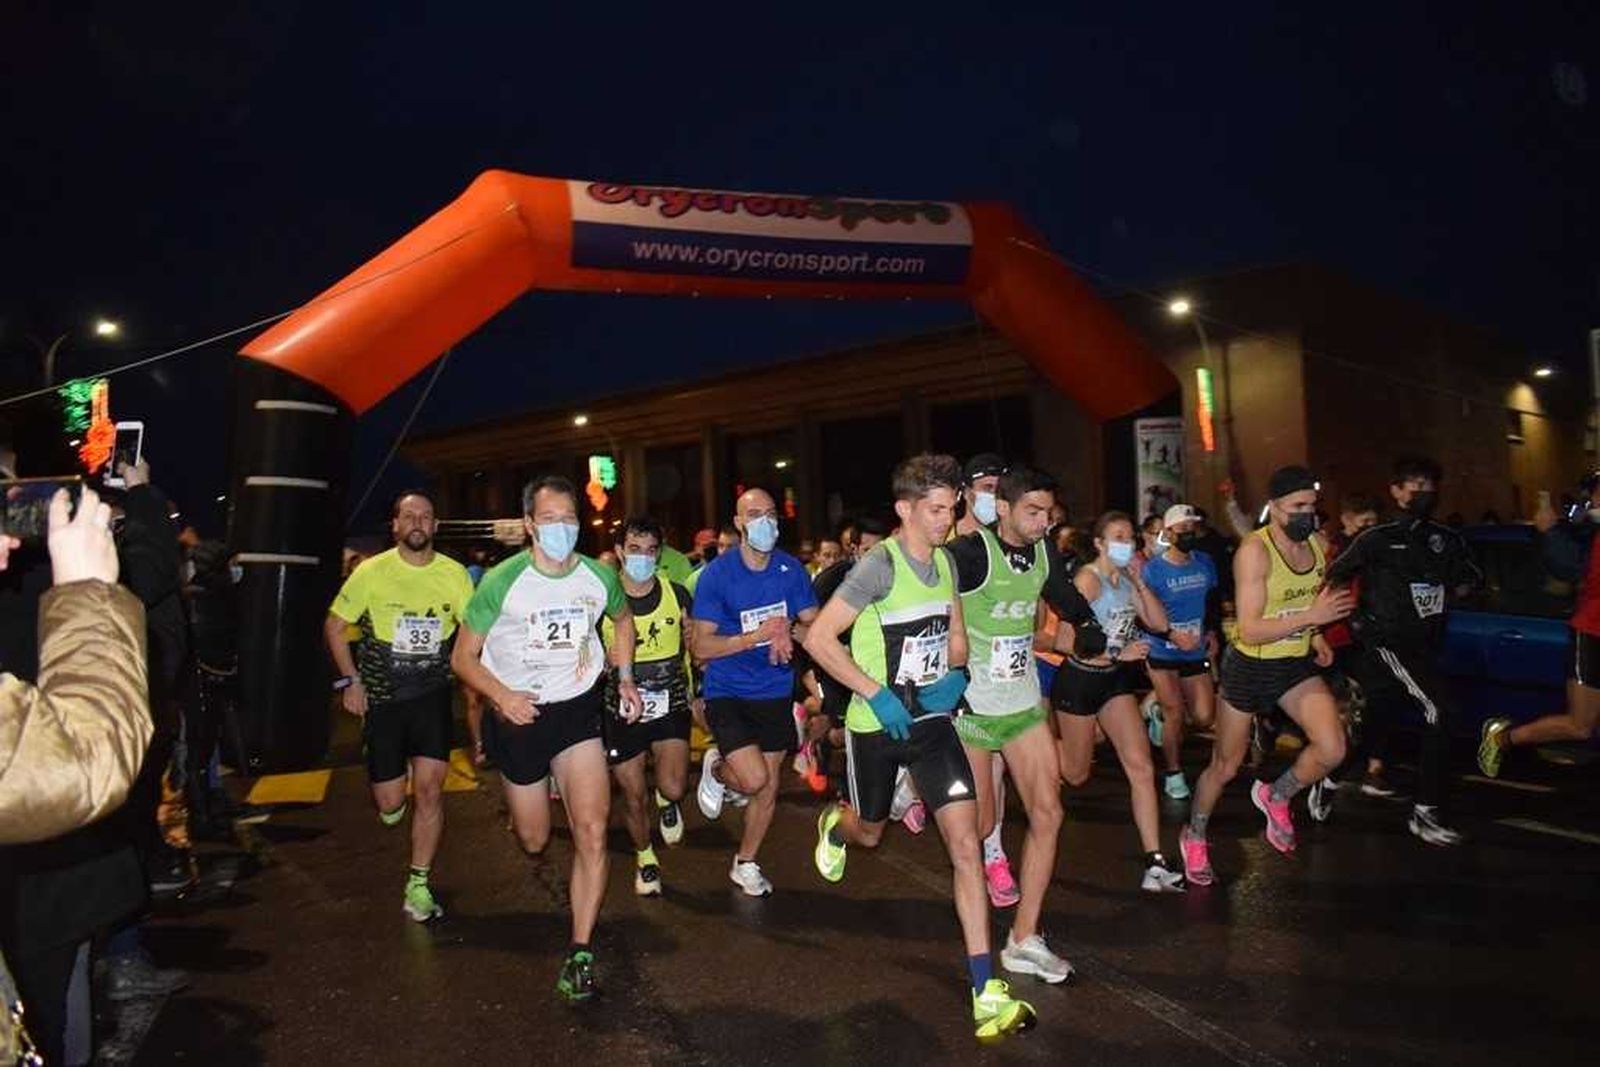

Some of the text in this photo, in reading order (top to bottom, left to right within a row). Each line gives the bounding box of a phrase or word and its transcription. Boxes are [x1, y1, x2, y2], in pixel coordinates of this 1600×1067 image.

[632, 240, 926, 275] www.orycronsport.com
[409, 629, 431, 645] 33
[547, 620, 571, 641] 21
[922, 650, 940, 672] 14
[1009, 649, 1028, 669] 26
